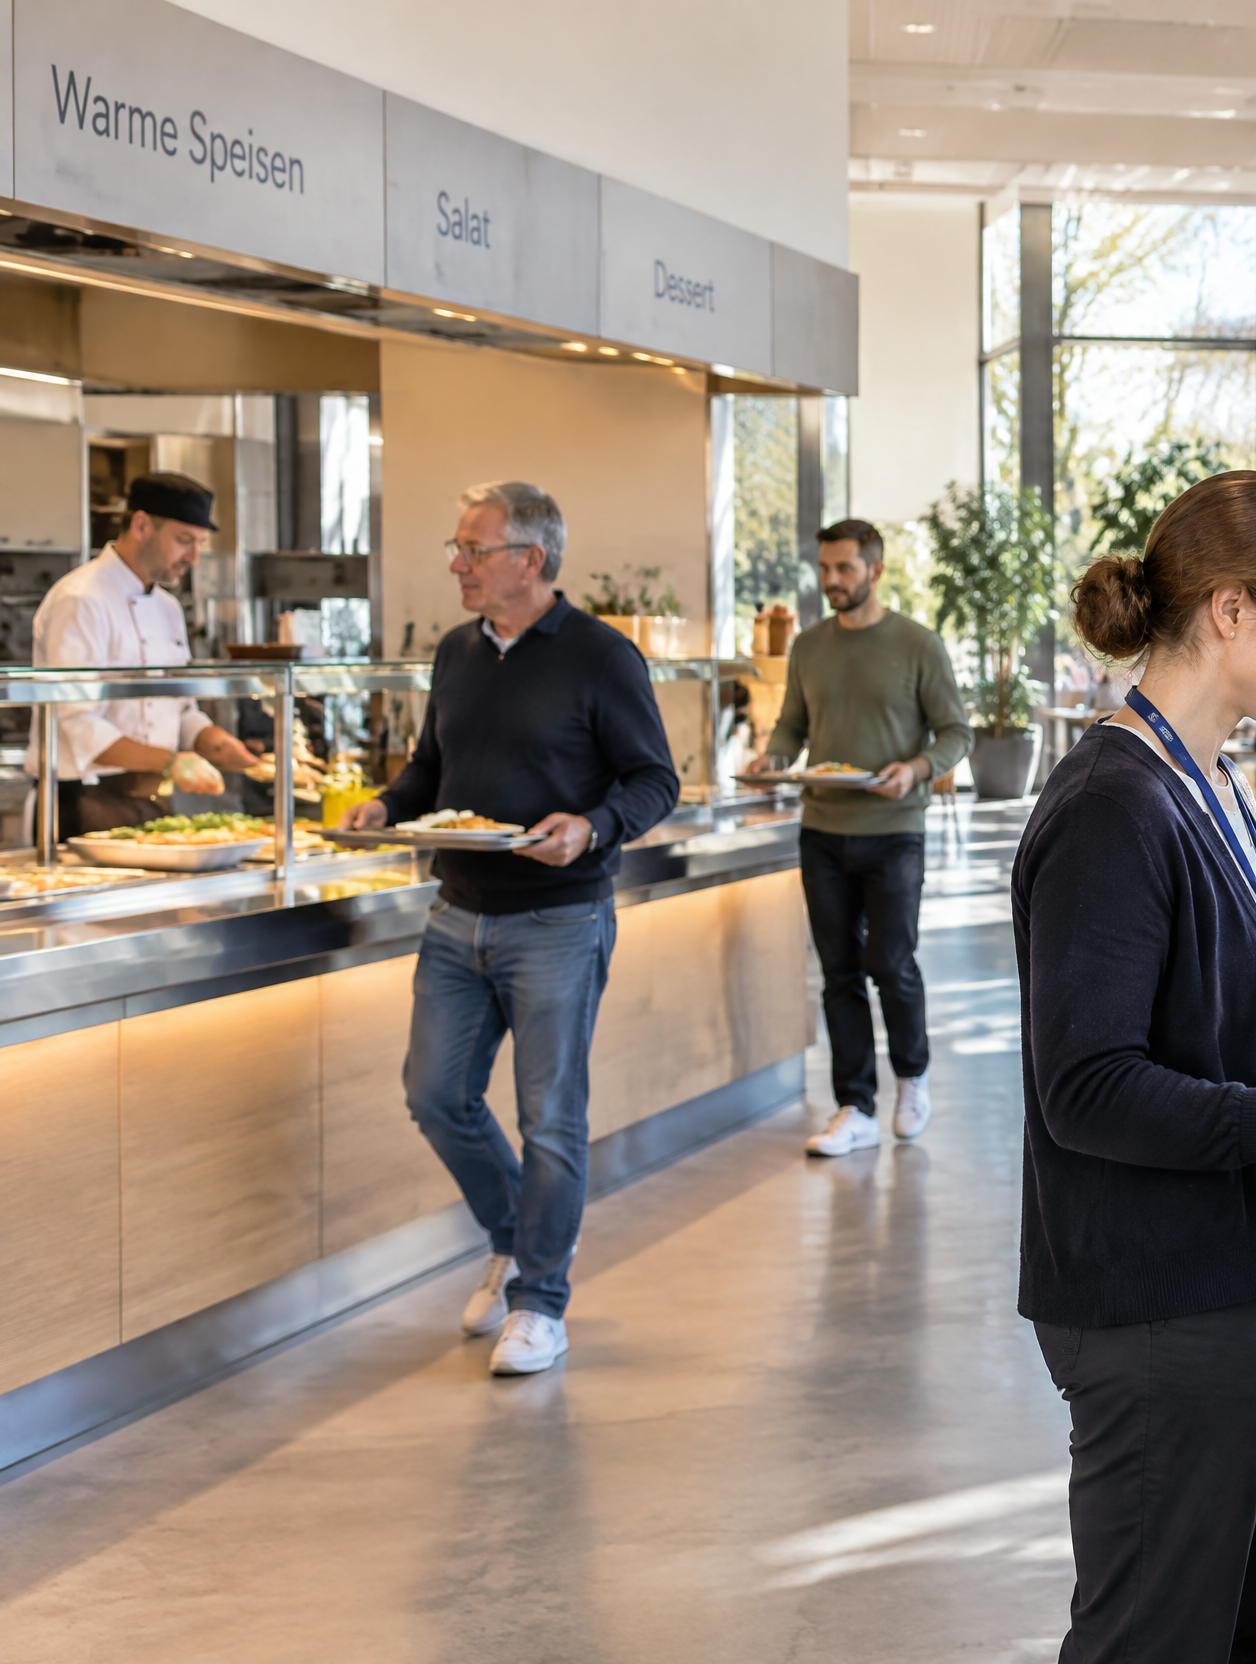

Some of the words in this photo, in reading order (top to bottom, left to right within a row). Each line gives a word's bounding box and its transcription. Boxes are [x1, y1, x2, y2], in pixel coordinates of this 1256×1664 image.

[51, 64, 178, 158] Warme
[189, 110, 305, 195] Speisen
[436, 191, 491, 249] Salat
[654, 260, 715, 313] Dessert
